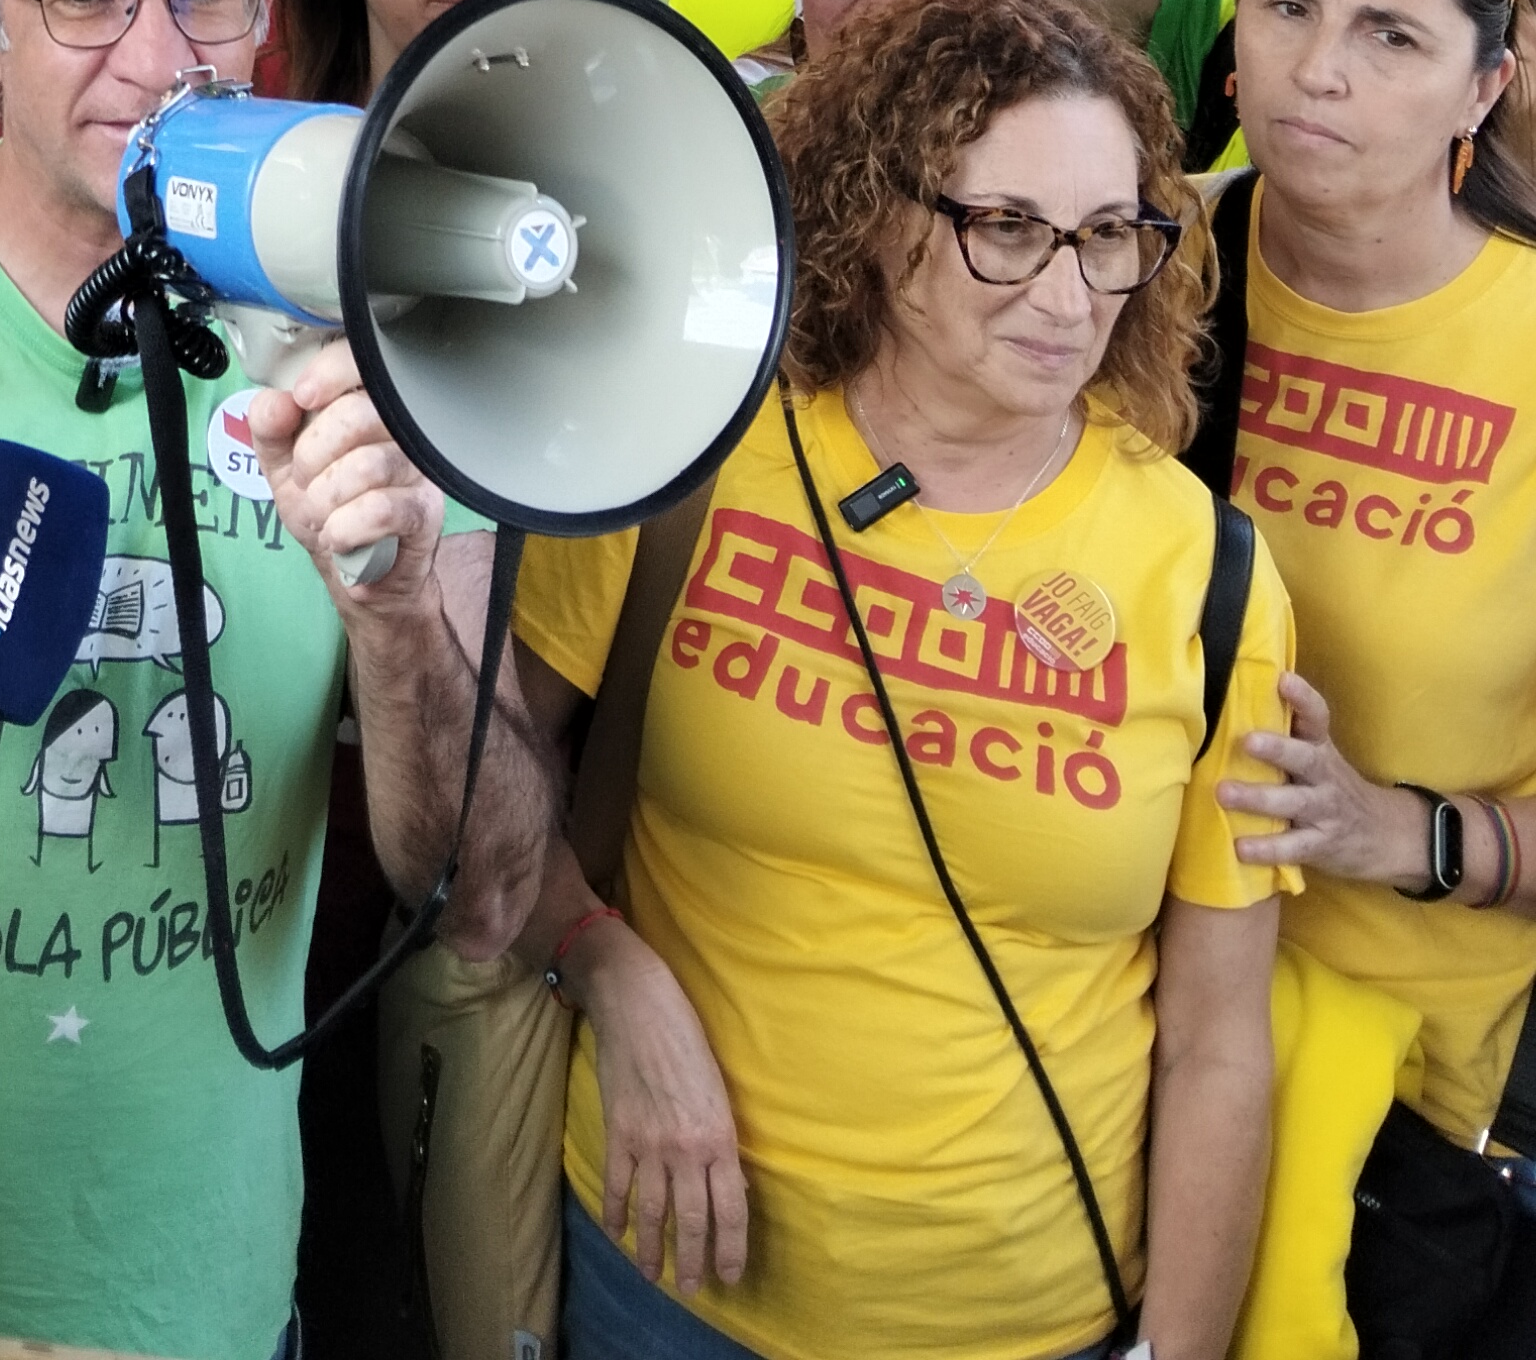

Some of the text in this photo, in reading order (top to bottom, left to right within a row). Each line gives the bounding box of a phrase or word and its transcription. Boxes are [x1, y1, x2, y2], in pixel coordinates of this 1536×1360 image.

[171, 180, 214, 203] VONYX
[1020, 587, 1099, 657] VAGA!
[1041, 571, 1112, 631] JO FAIG
[671, 618, 1122, 811] educació
